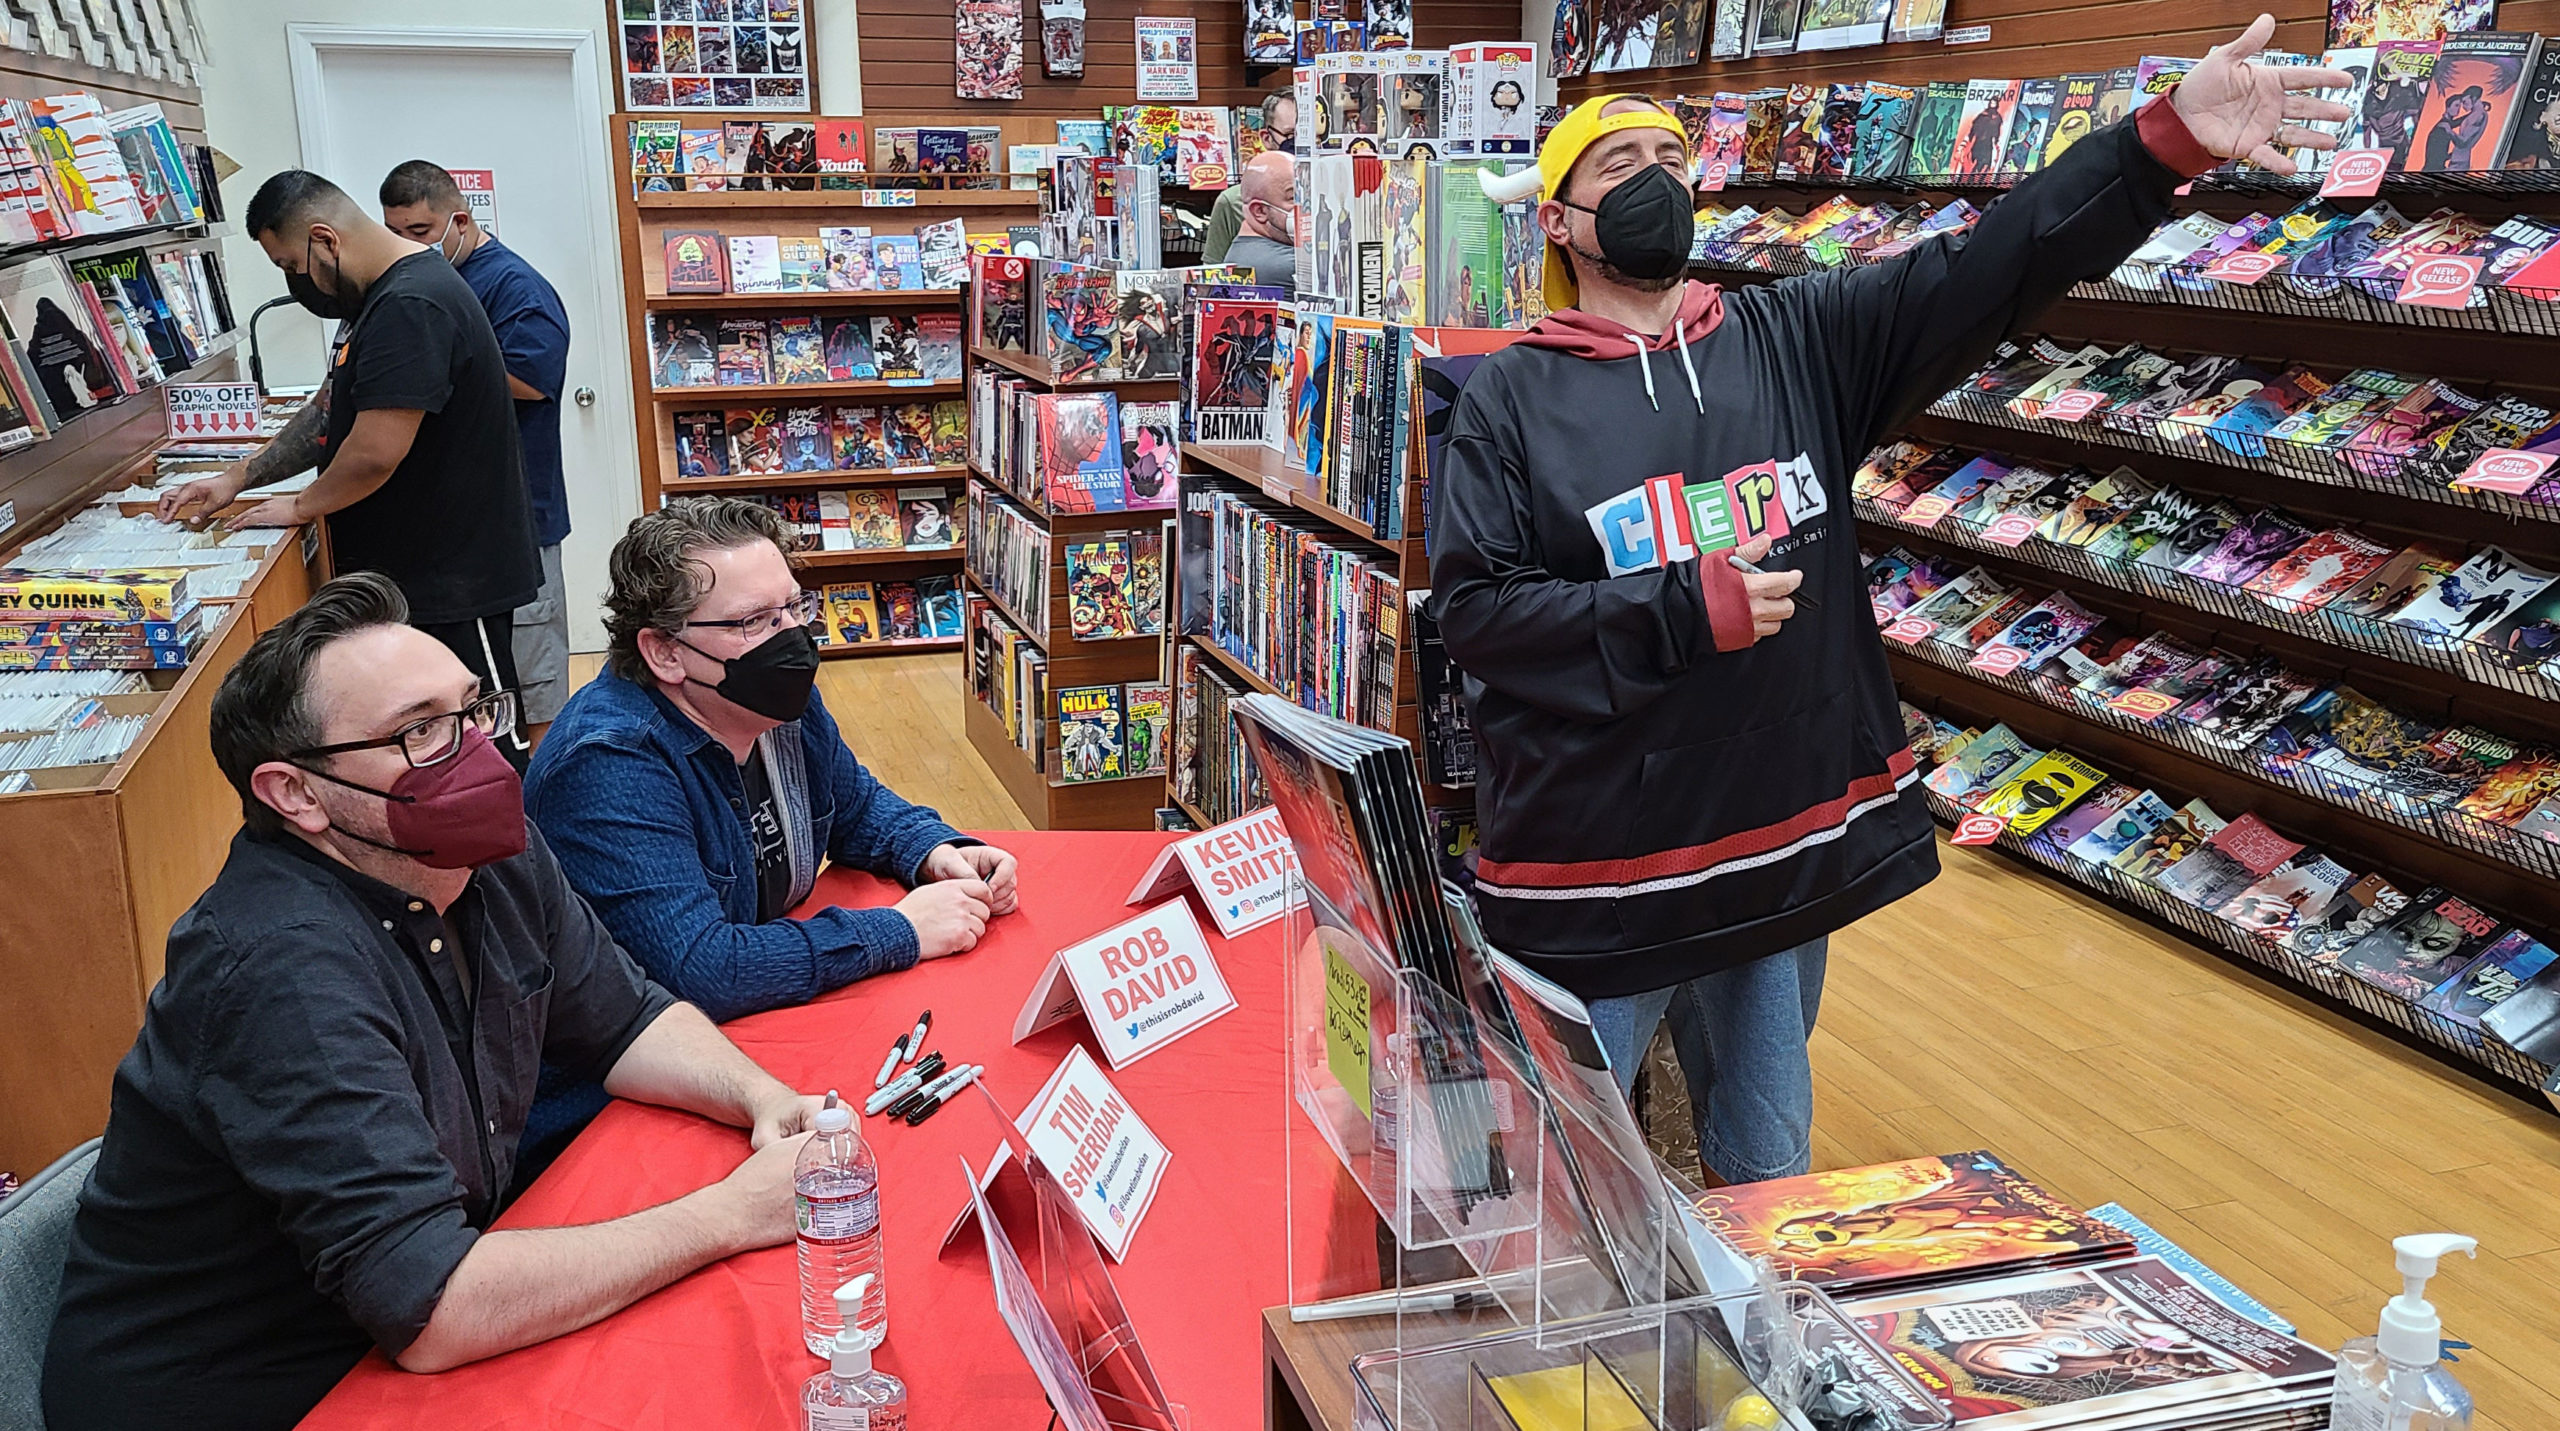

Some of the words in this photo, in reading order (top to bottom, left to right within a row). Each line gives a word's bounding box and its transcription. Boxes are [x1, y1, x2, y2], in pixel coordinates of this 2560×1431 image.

[2443, 41, 2468, 50] HOUSE
[2476, 41, 2526, 51] SLAUGHTER
[1497, 54, 1519, 66] POP!
[2264, 56, 2291, 66] ONCE
[1927, 89, 1967, 100] BASILIS
[2068, 81, 2096, 96] DARK
[2534, 88, 2560, 104] CH
[2063, 95, 2093, 109] BLOOD
[685, 136, 708, 149] CHEER
[818, 159, 865, 172] Youth
[2341, 167, 2376, 176] RELEASE
[2351, 160, 2372, 169] NEW
[453, 174, 482, 189] TICE
[864, 191, 894, 205] PRIDE
[2490, 219, 2558, 248] BUF
[92, 256, 139, 281] DIARY
[2432, 266, 2459, 276] NEW
[735, 279, 783, 293] Spinning
[1362, 250, 1382, 320] ATCHMEN
[2420, 274, 2463, 285] RELEASE
[169, 388, 213, 403] 50%
[217, 387, 254, 402] OFF
[170, 403, 215, 412] GRAPHIC
[217, 402, 257, 411] NOVELS
[788, 405, 822, 418] HOME
[2501, 399, 2550, 420] GOOD
[1201, 413, 1264, 441] BATMAN
[2494, 409, 2553, 429] ASIAN
[1381, 434, 1392, 491] MORRISON
[2487, 464, 2532, 476] RELEASE
[2502, 457, 2525, 468] NEW
[1056, 473, 1121, 485] SPIDER-MAN
[1072, 482, 1093, 491] LIFE
[1093, 480, 1121, 490] STORY
[856, 493, 889, 506] CODA
[1187, 491, 1213, 513] JOK
[1074, 550, 1127, 568] AVENGERS
[0, 595, 23, 609] EY
[28, 593, 106, 611] QUINN
[2142, 645, 2194, 667] APOCALYPSE
[1061, 694, 1110, 713] HULK
[1133, 689, 1169, 703] Fantas
[2443, 729, 2517, 760] BASTARDS
[2068, 758, 2104, 783] JENNIKA
[1194, 815, 1290, 869] KEVIN
[2311, 867, 2341, 888] COUN
[2434, 901, 2492, 938] DEAD
[1099, 927, 1169, 980] ROB
[1101, 954, 1198, 1022] DAVID
[1139, 990, 1205, 1033] @thisisrobdavid
[1049, 1083, 1095, 1146] TIM
[1062, 1092, 1125, 1198] SHERIDAN
[1941, 1318, 1959, 1330] SIX
[1975, 1309, 2004, 1332] STRAY
[1990, 1309, 2016, 1329] DOGS
[1892, 1350, 1920, 1374] DAYS
[1919, 1371, 1948, 1390] DOG
